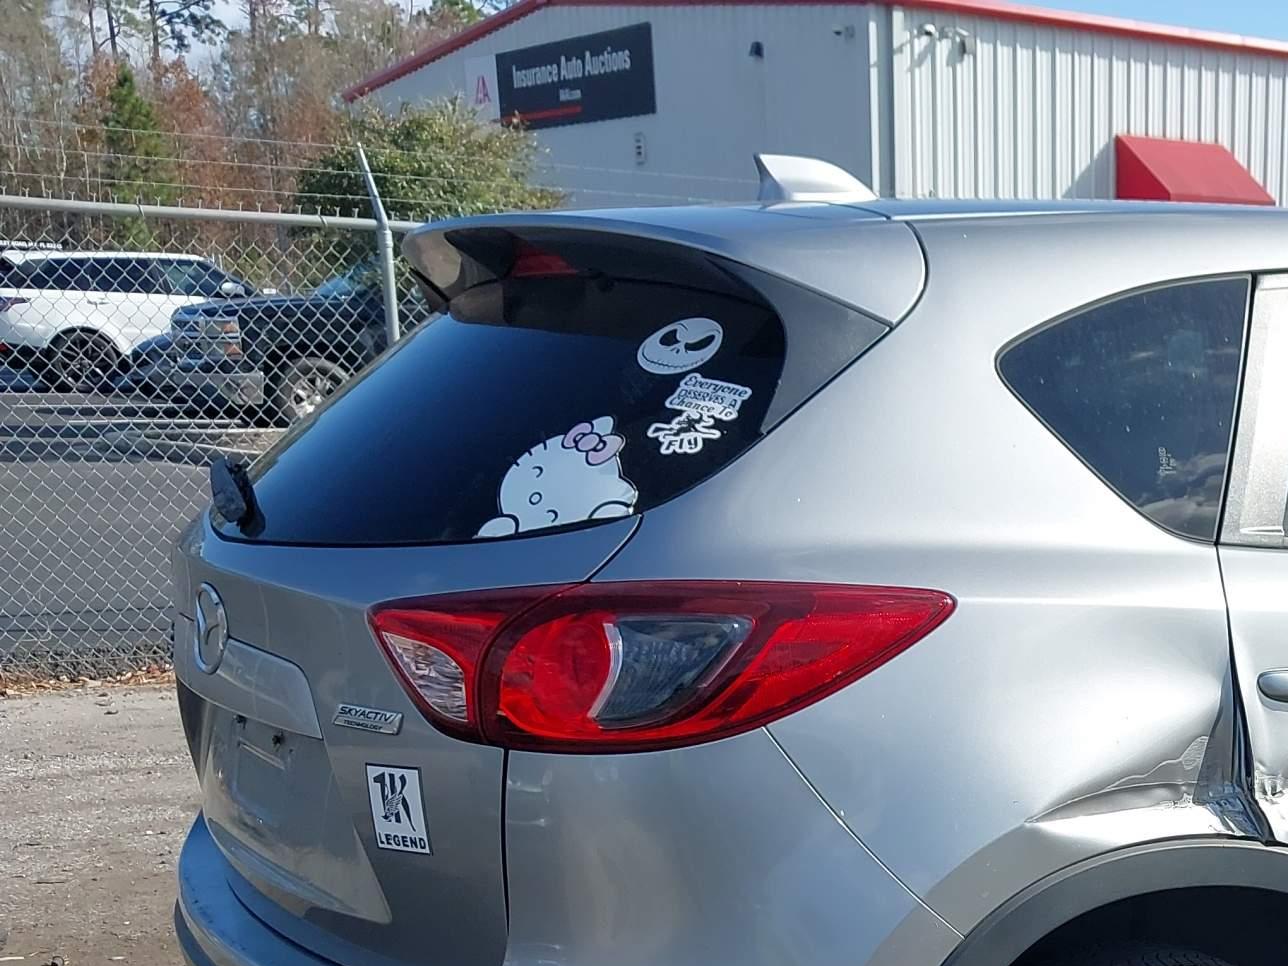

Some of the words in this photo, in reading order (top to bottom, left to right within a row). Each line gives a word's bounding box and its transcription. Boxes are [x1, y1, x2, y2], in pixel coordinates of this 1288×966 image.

[512, 64, 559, 89] Insurance
[560, 54, 583, 81] Auto
[584, 46, 632, 77] Auctions
[684, 375, 748, 397] Everyone
[669, 396, 715, 413] Chance
[719, 405, 733, 418] To
[728, 398, 738, 409] A
[338, 705, 395, 723] SKYACTIV
[343, 718, 383, 731] TECHNOLOGY
[378, 831, 427, 850] LEGEND
